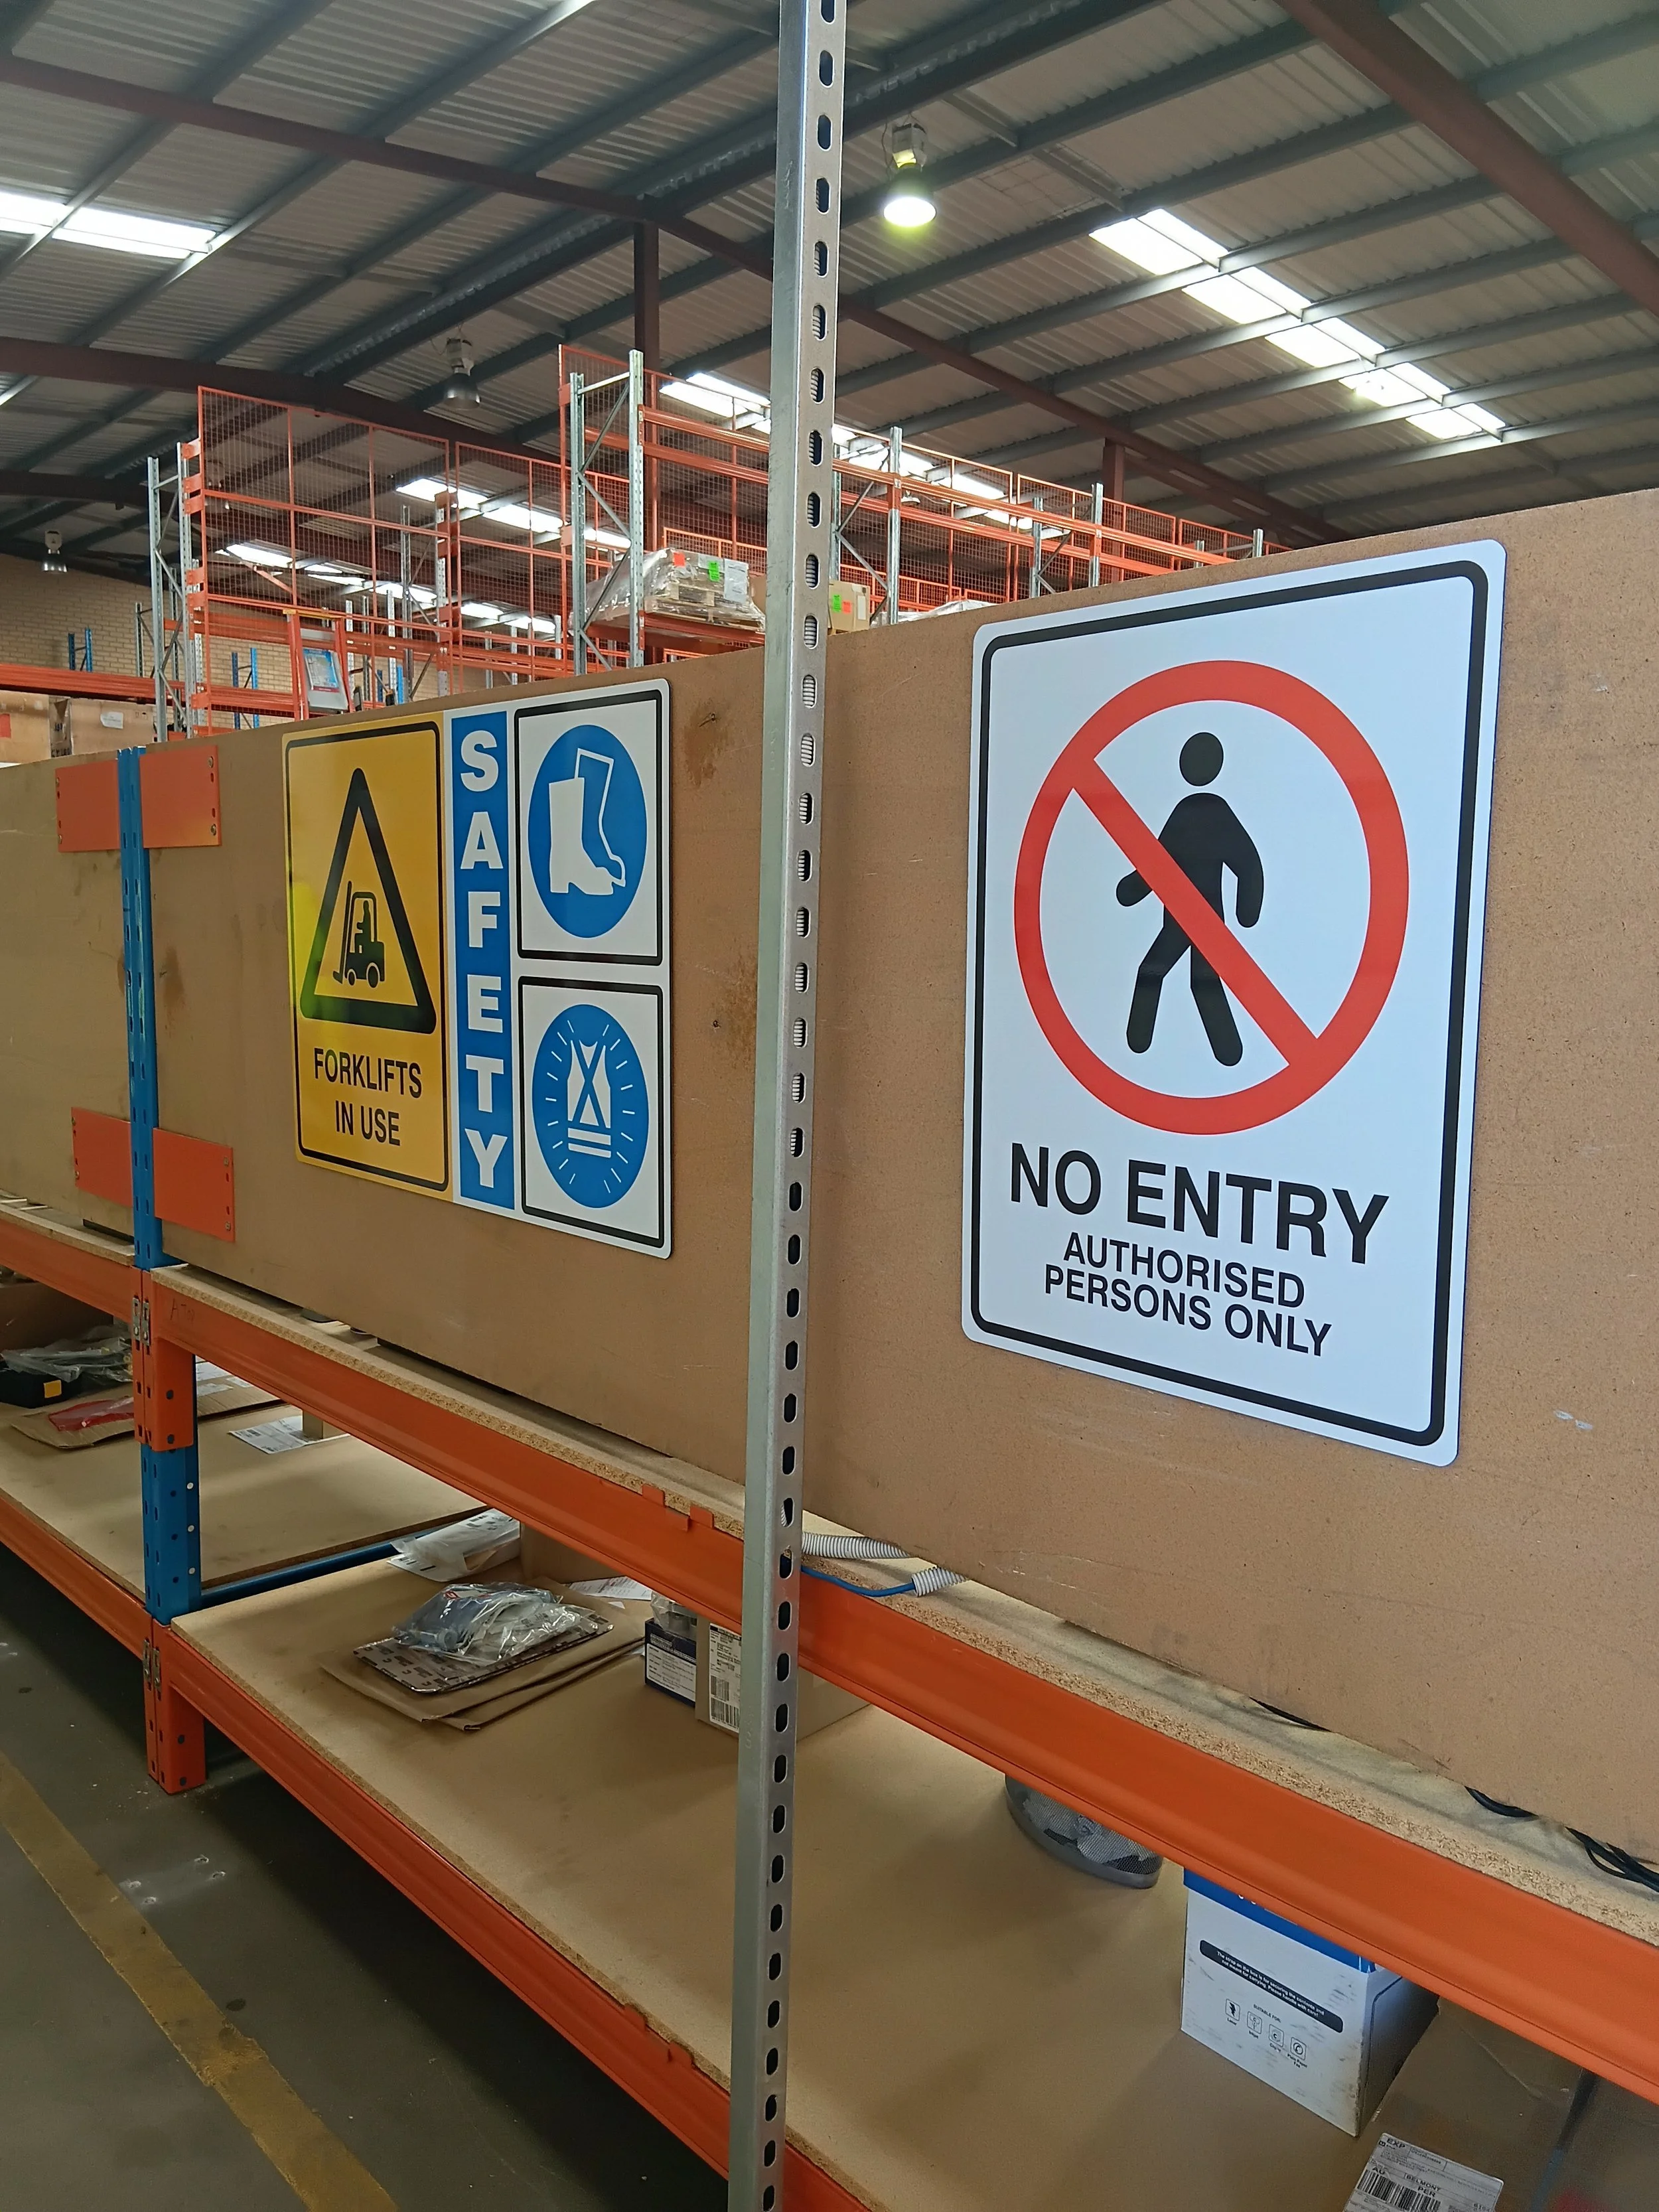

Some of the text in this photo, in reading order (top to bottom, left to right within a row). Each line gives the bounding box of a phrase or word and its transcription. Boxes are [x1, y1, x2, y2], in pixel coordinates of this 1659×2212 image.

[460, 730, 508, 1189] SAFETY
[314, 1047, 422, 1098] FORKLIFTS
[335, 1100, 401, 1146] IN USE
[1011, 1142, 1390, 1265] NO ENTRY
[1063, 1232, 1305, 1308] AUTHORISED
[1045, 1264, 1332, 1357] PERSONS ONLY
[1226, 1956, 1236, 1966] strap
[1270, 1982, 1288, 1996] securing
[1297, 1997, 1315, 2010] contents
[1230, 1964, 1242, 1973] meant
[1268, 1985, 1282, 1996] Please
[1283, 1993, 1297, 2004] handle
[1253, 2004, 1271, 2018] SUITABLE
[1386, 2138, 1406, 2148] EXP
[1406, 2174, 1441, 2191] BELMONT
[1417, 2186, 1436, 2197] PER
